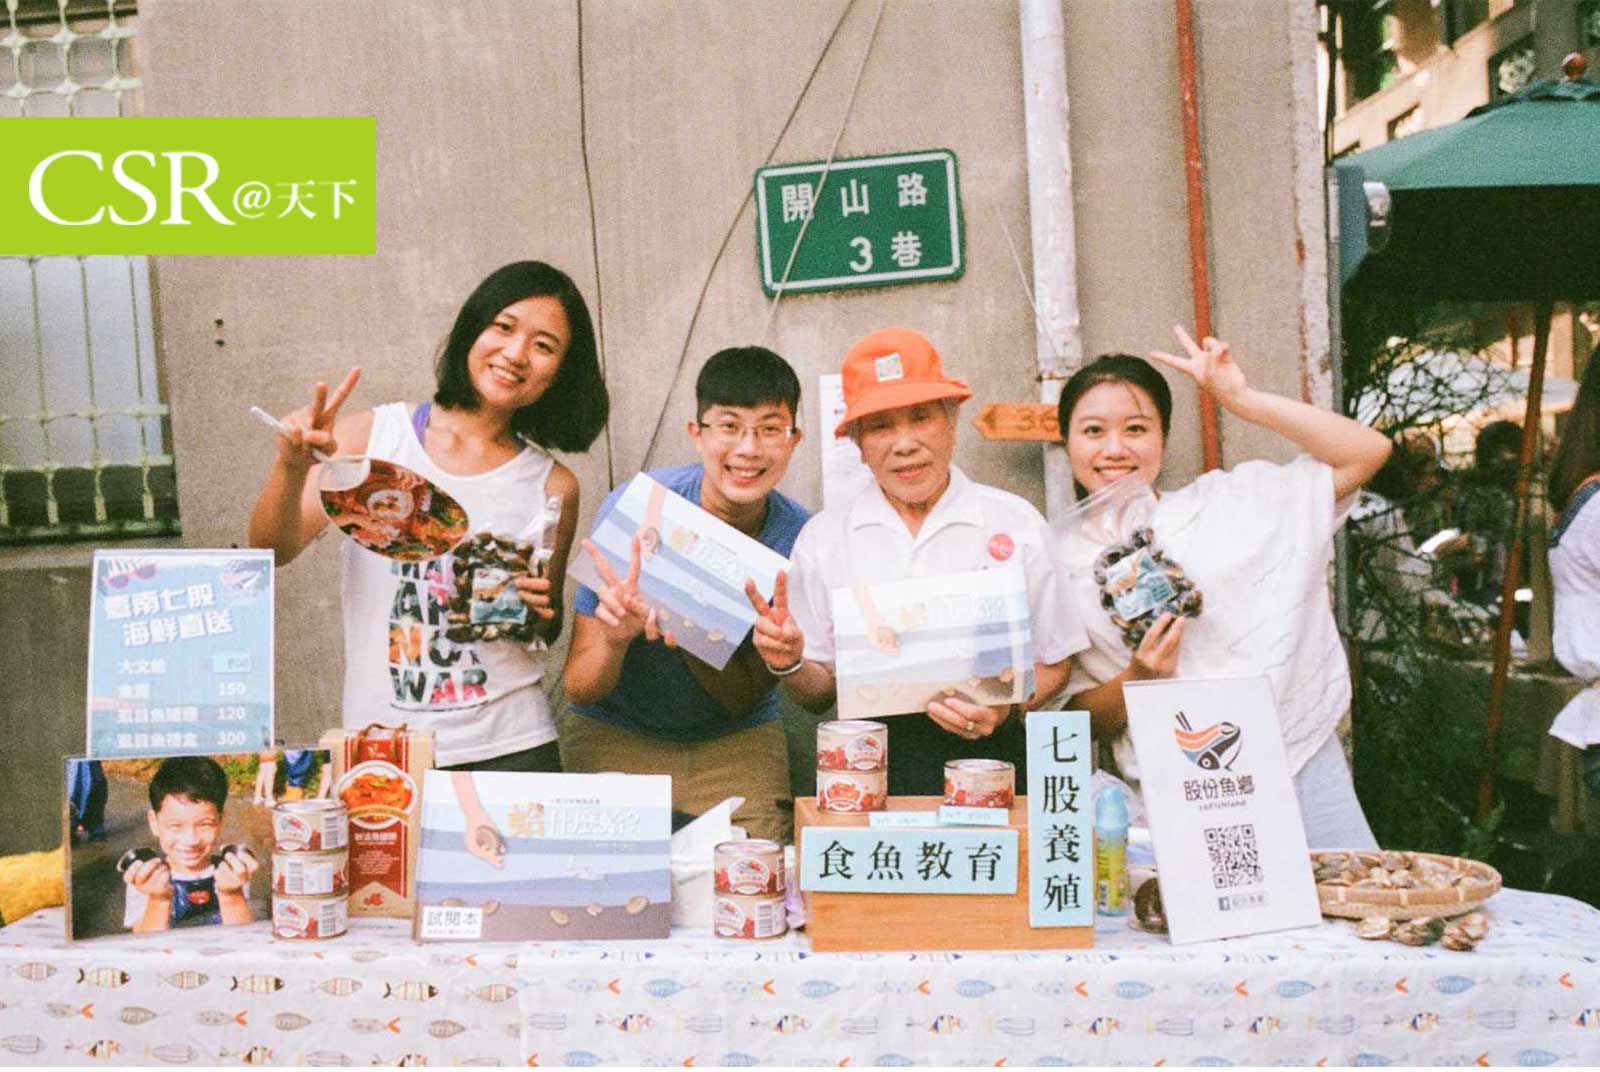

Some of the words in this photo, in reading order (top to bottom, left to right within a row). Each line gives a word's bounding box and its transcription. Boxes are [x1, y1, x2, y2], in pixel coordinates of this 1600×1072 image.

[781, 172, 928, 223] 開山路
[849, 231, 922, 273] 3巷
[1016, 405, 1059, 432] 36
[123, 608, 235, 647] 海鮮直送
[389, 667, 488, 703] WAR
[216, 706, 247, 721] 120
[216, 730, 247, 746] 300
[1184, 775, 1256, 801] 股份魚鄉
[1041, 725, 1082, 913] 七股養殖
[818, 840, 1004, 882] 食魚教育
